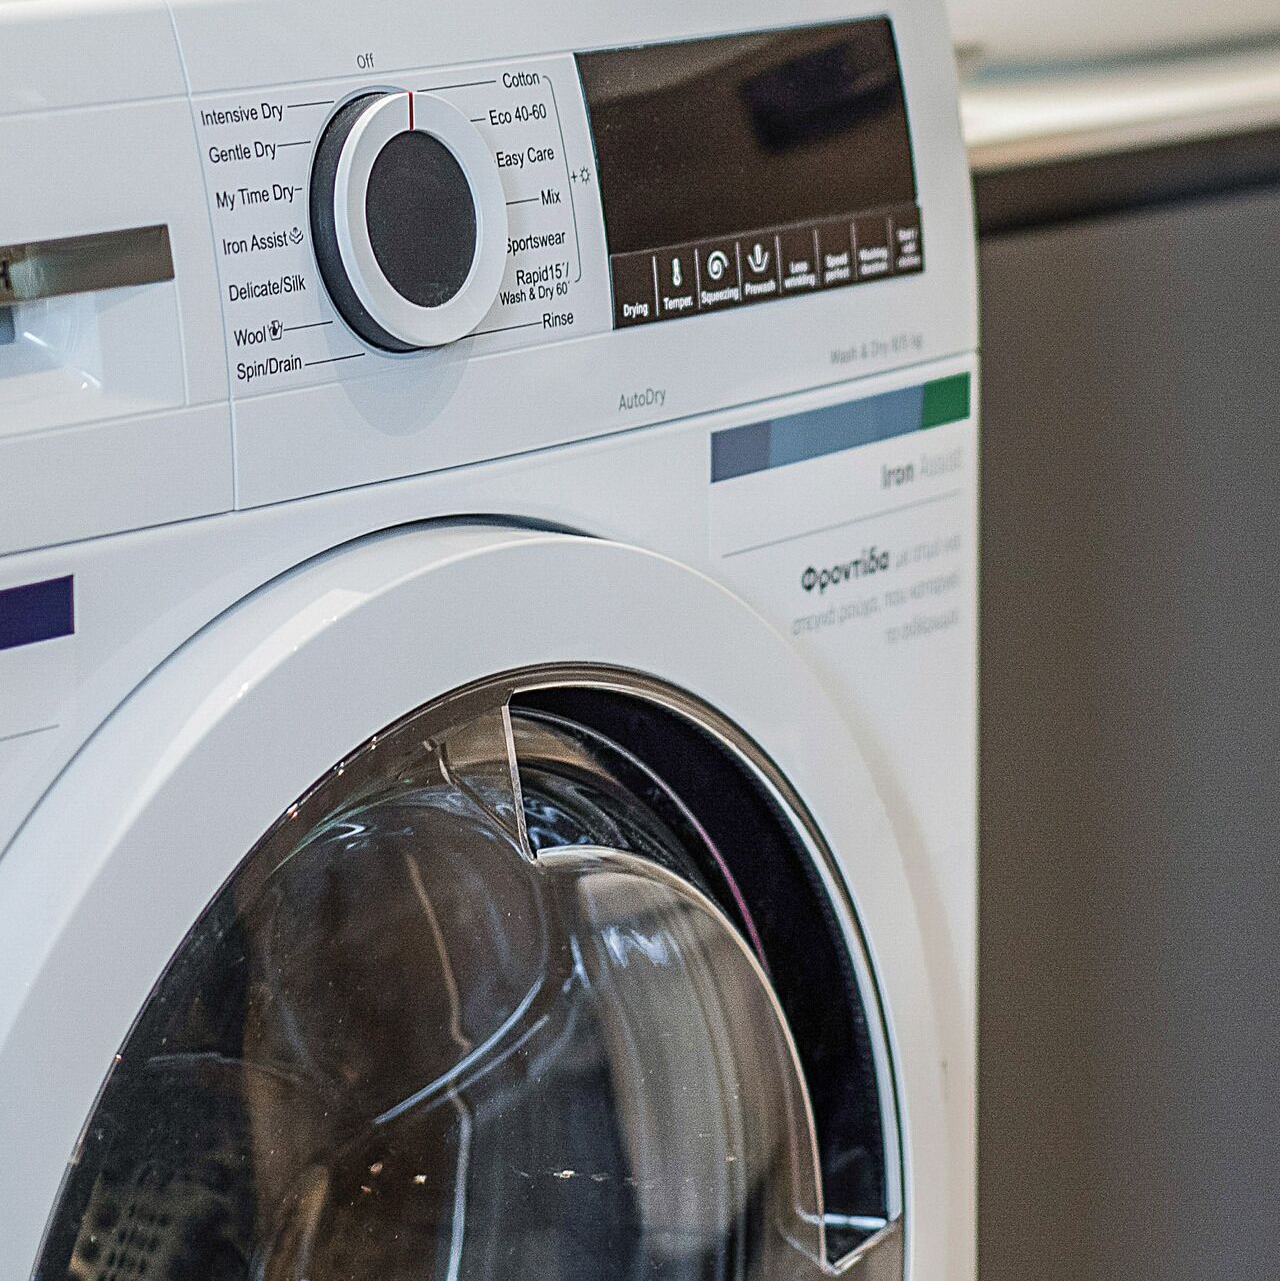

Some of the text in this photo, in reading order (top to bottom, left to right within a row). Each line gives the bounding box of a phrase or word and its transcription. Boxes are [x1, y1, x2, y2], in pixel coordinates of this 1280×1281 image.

[357, 53, 374, 69] Off
[502, 71, 540, 89] Cotton
[200, 103, 283, 127] Intensive Dry
[489, 104, 547, 126] Eco 40-60
[209, 141, 276, 164] Gentle Dry
[496, 147, 554, 170] Easy Care
[216, 184, 294, 210] My Time Dry
[541, 189, 561, 206] Mix
[222, 231, 288, 256] Iron Assist
[507, 230, 565, 255] Sportswear
[228, 276, 306, 302] Delicate/Silk
[500, 289, 526, 306] Wash
[528, 288, 537, 301] &
[538, 285, 554, 303] Dry
[623, 302, 649, 318] Drying
[663, 295, 694, 311] Temper.
[542, 311, 573, 329] Rinse
[234, 326, 266, 346] Wool
[236, 355, 302, 380] Spin/Drain
[618, 387, 666, 412] AutoDry
